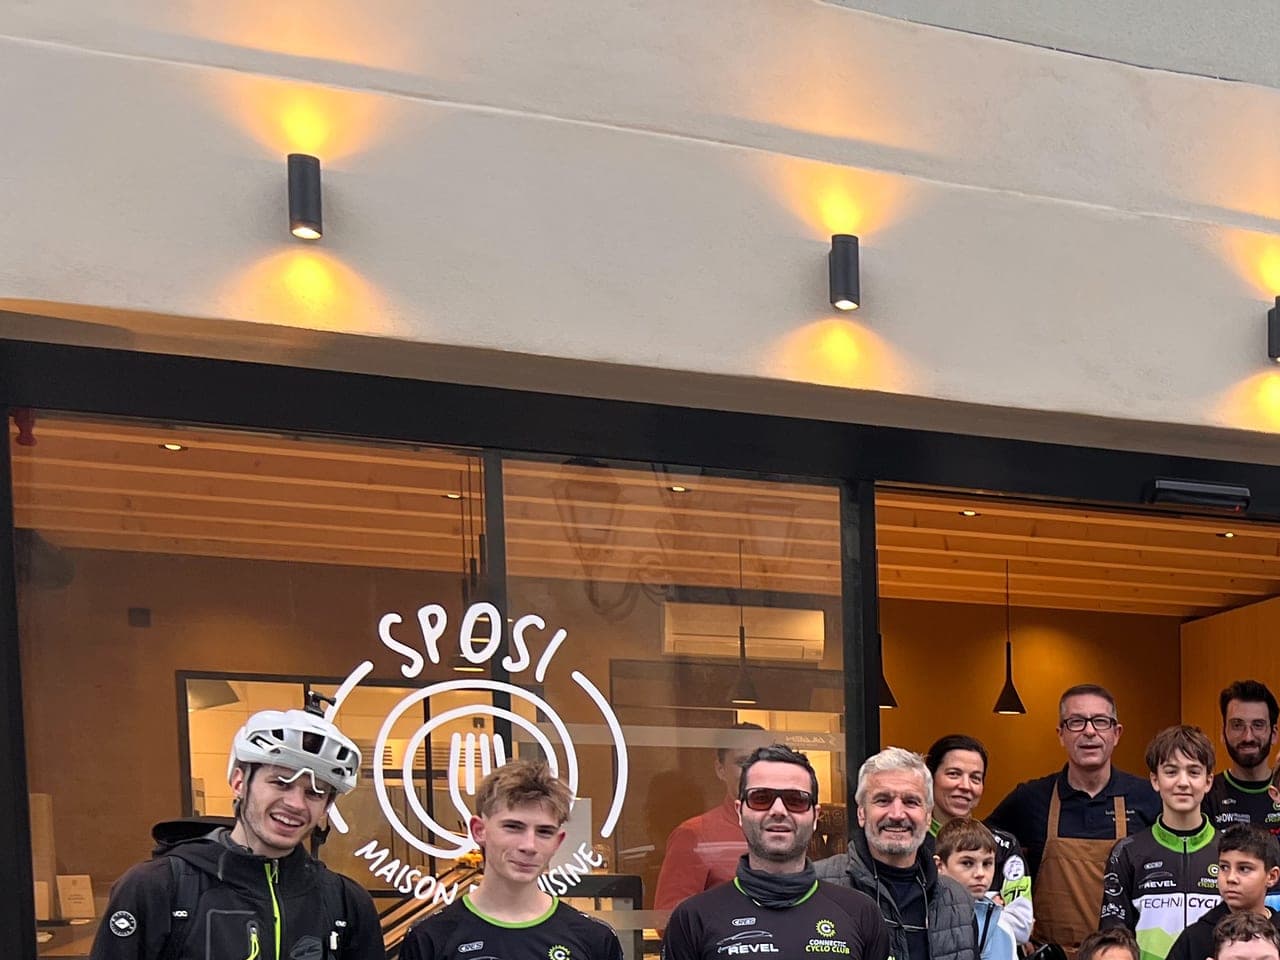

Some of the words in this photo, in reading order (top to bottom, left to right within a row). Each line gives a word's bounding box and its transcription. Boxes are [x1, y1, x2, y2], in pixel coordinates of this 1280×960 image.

[378, 602, 567, 683] SPOSI
[354, 840, 459, 905] MAISON
[537, 842, 603, 896] ISINE
[728, 943, 779, 956] REVEL
[805, 944, 829, 953] CYCLO
[831, 946, 850, 955] CLUB
[809, 939, 847, 948] CONNECTIC
